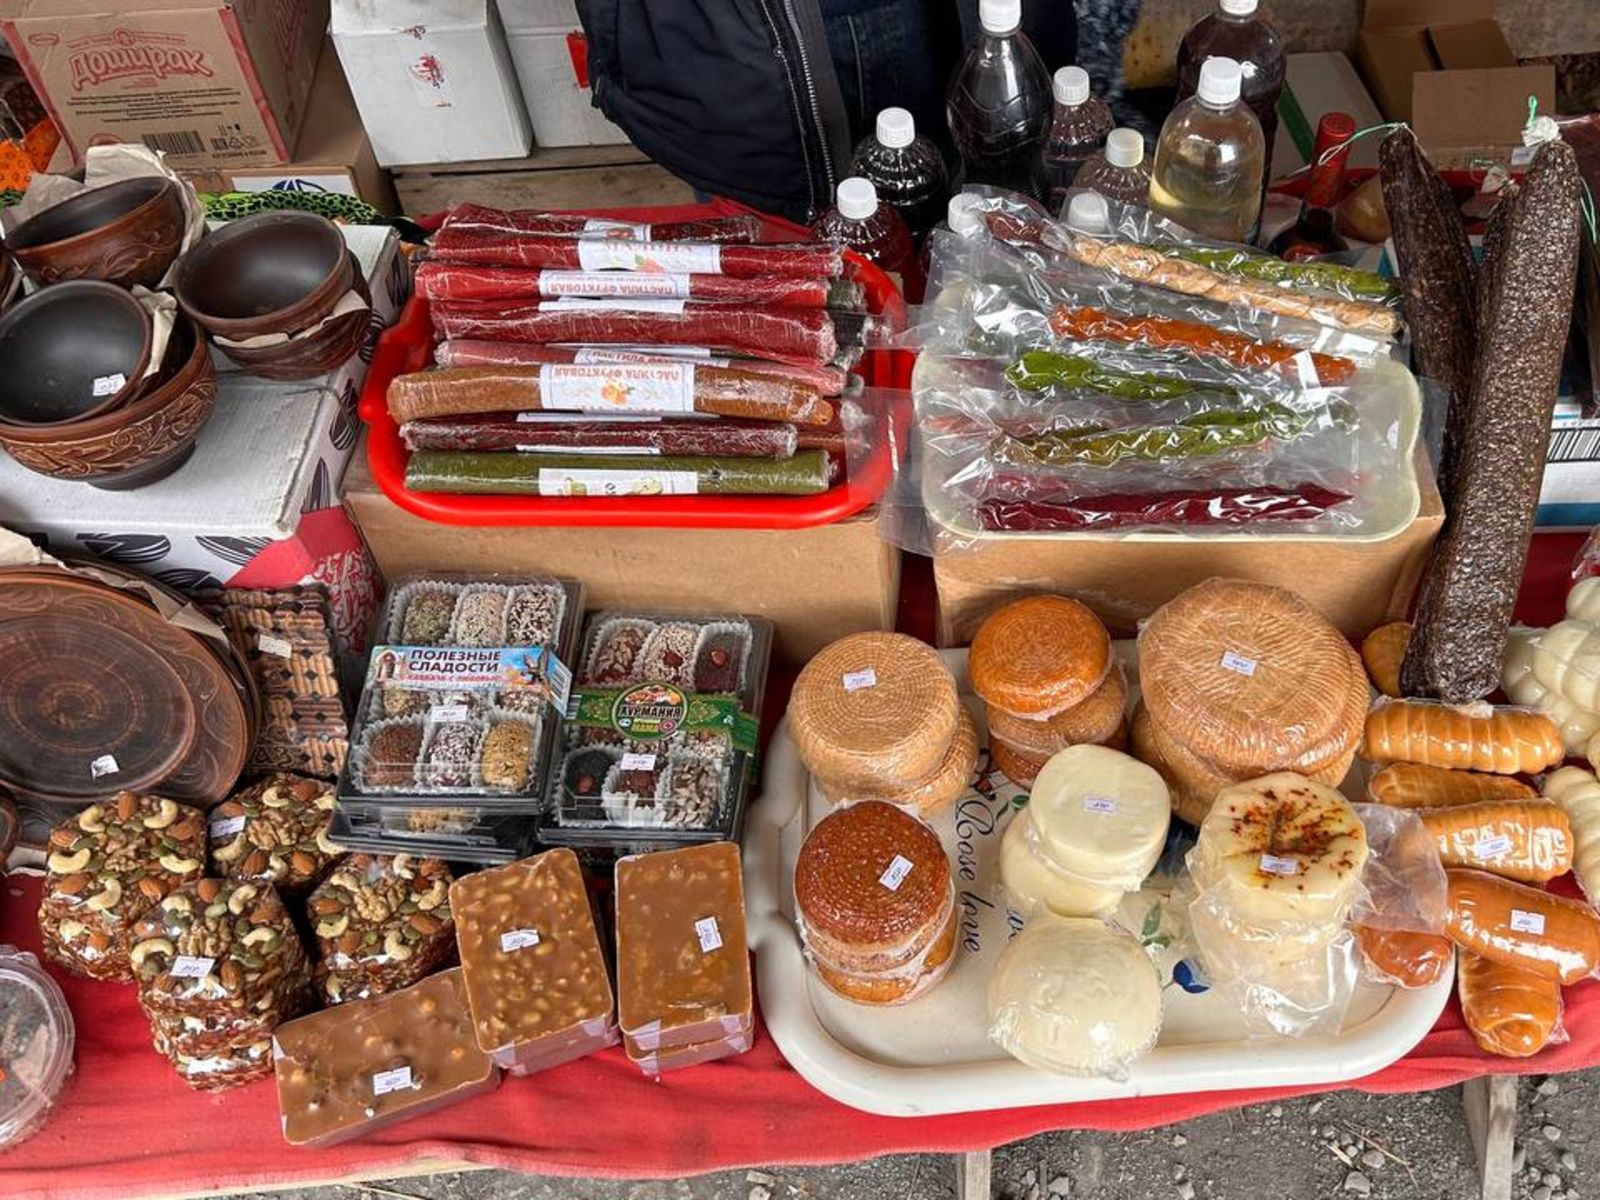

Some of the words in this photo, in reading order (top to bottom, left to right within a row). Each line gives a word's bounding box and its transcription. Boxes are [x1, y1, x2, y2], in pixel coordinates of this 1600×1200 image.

[69, 47, 213, 91] Доширак
[409, 661, 498, 673] СЛАДОСТИ
[411, 649, 501, 661] ПОЛЕЗНЫЕ
[955, 799, 995, 881] Rose
[959, 891, 996, 952] love
